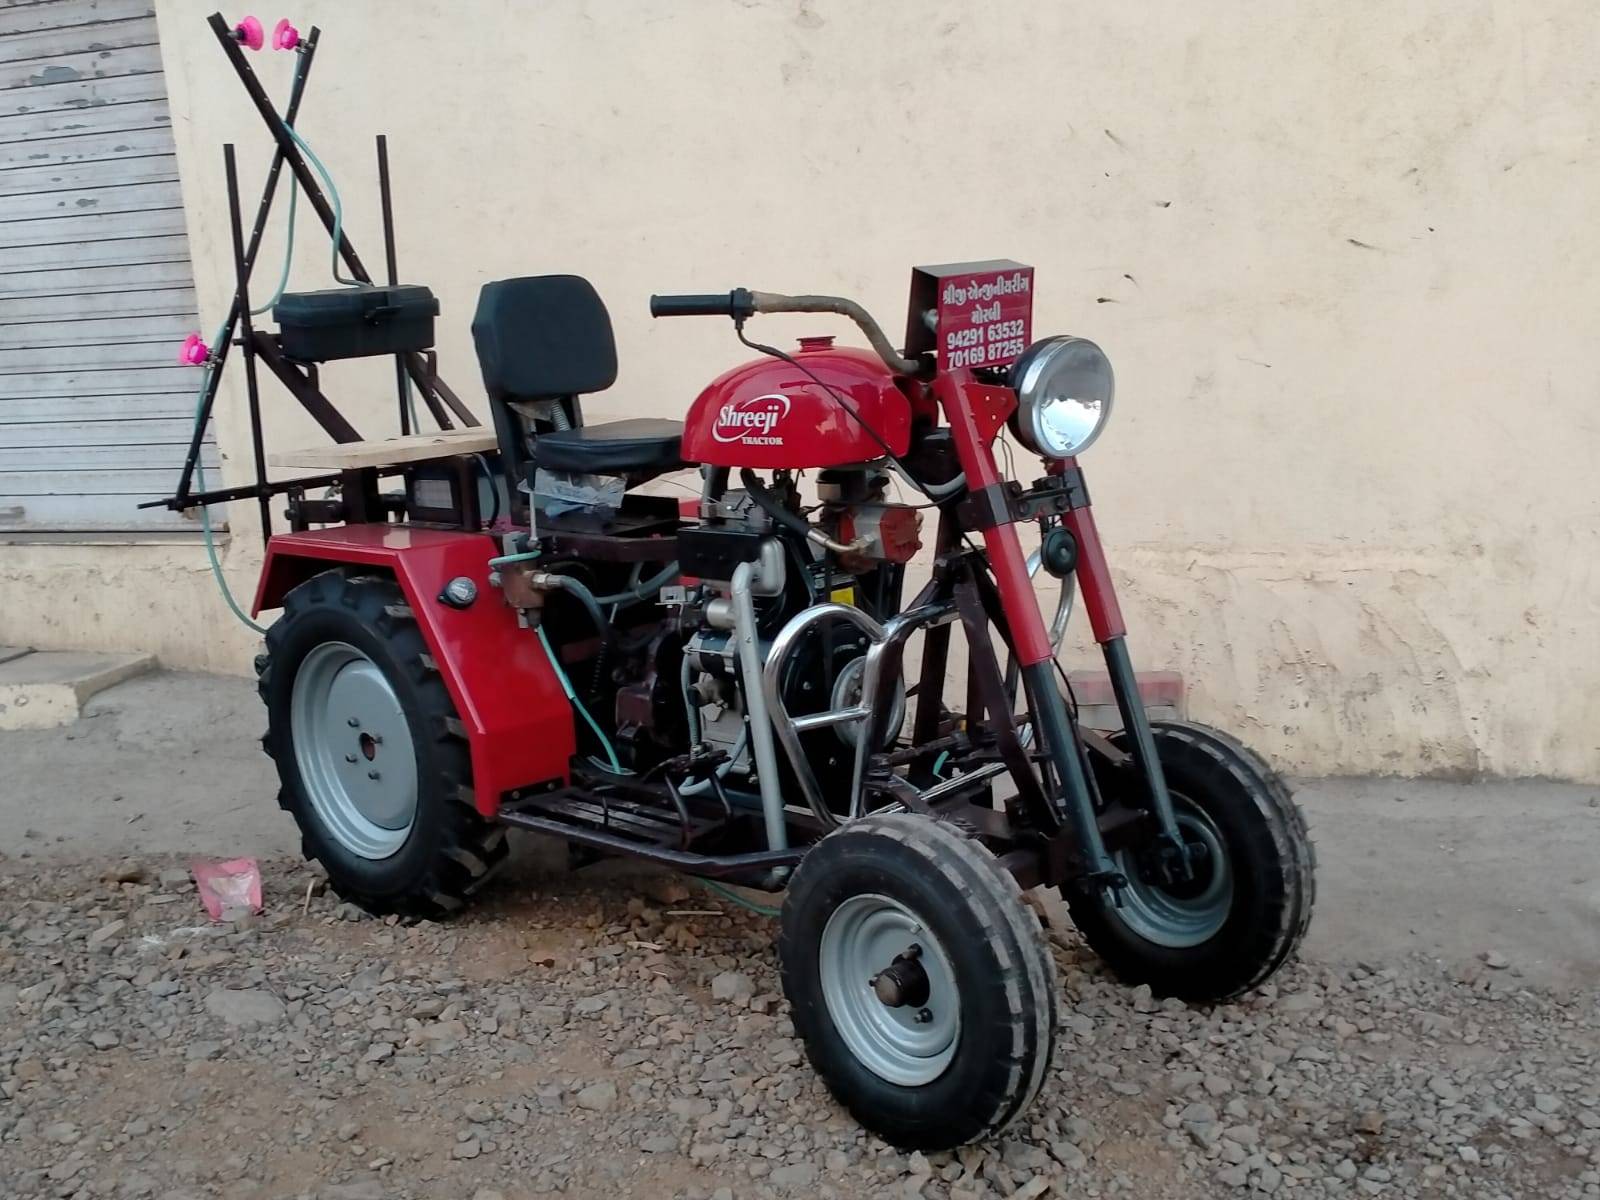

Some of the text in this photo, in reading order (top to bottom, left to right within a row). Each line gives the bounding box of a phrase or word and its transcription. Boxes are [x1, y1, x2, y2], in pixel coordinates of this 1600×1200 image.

[947, 319, 1024, 350] 94291 63532
[946, 338, 1024, 369] 70169 87255
[718, 404, 779, 435] Shreeji
[741, 436, 783, 445] TRACTOR
